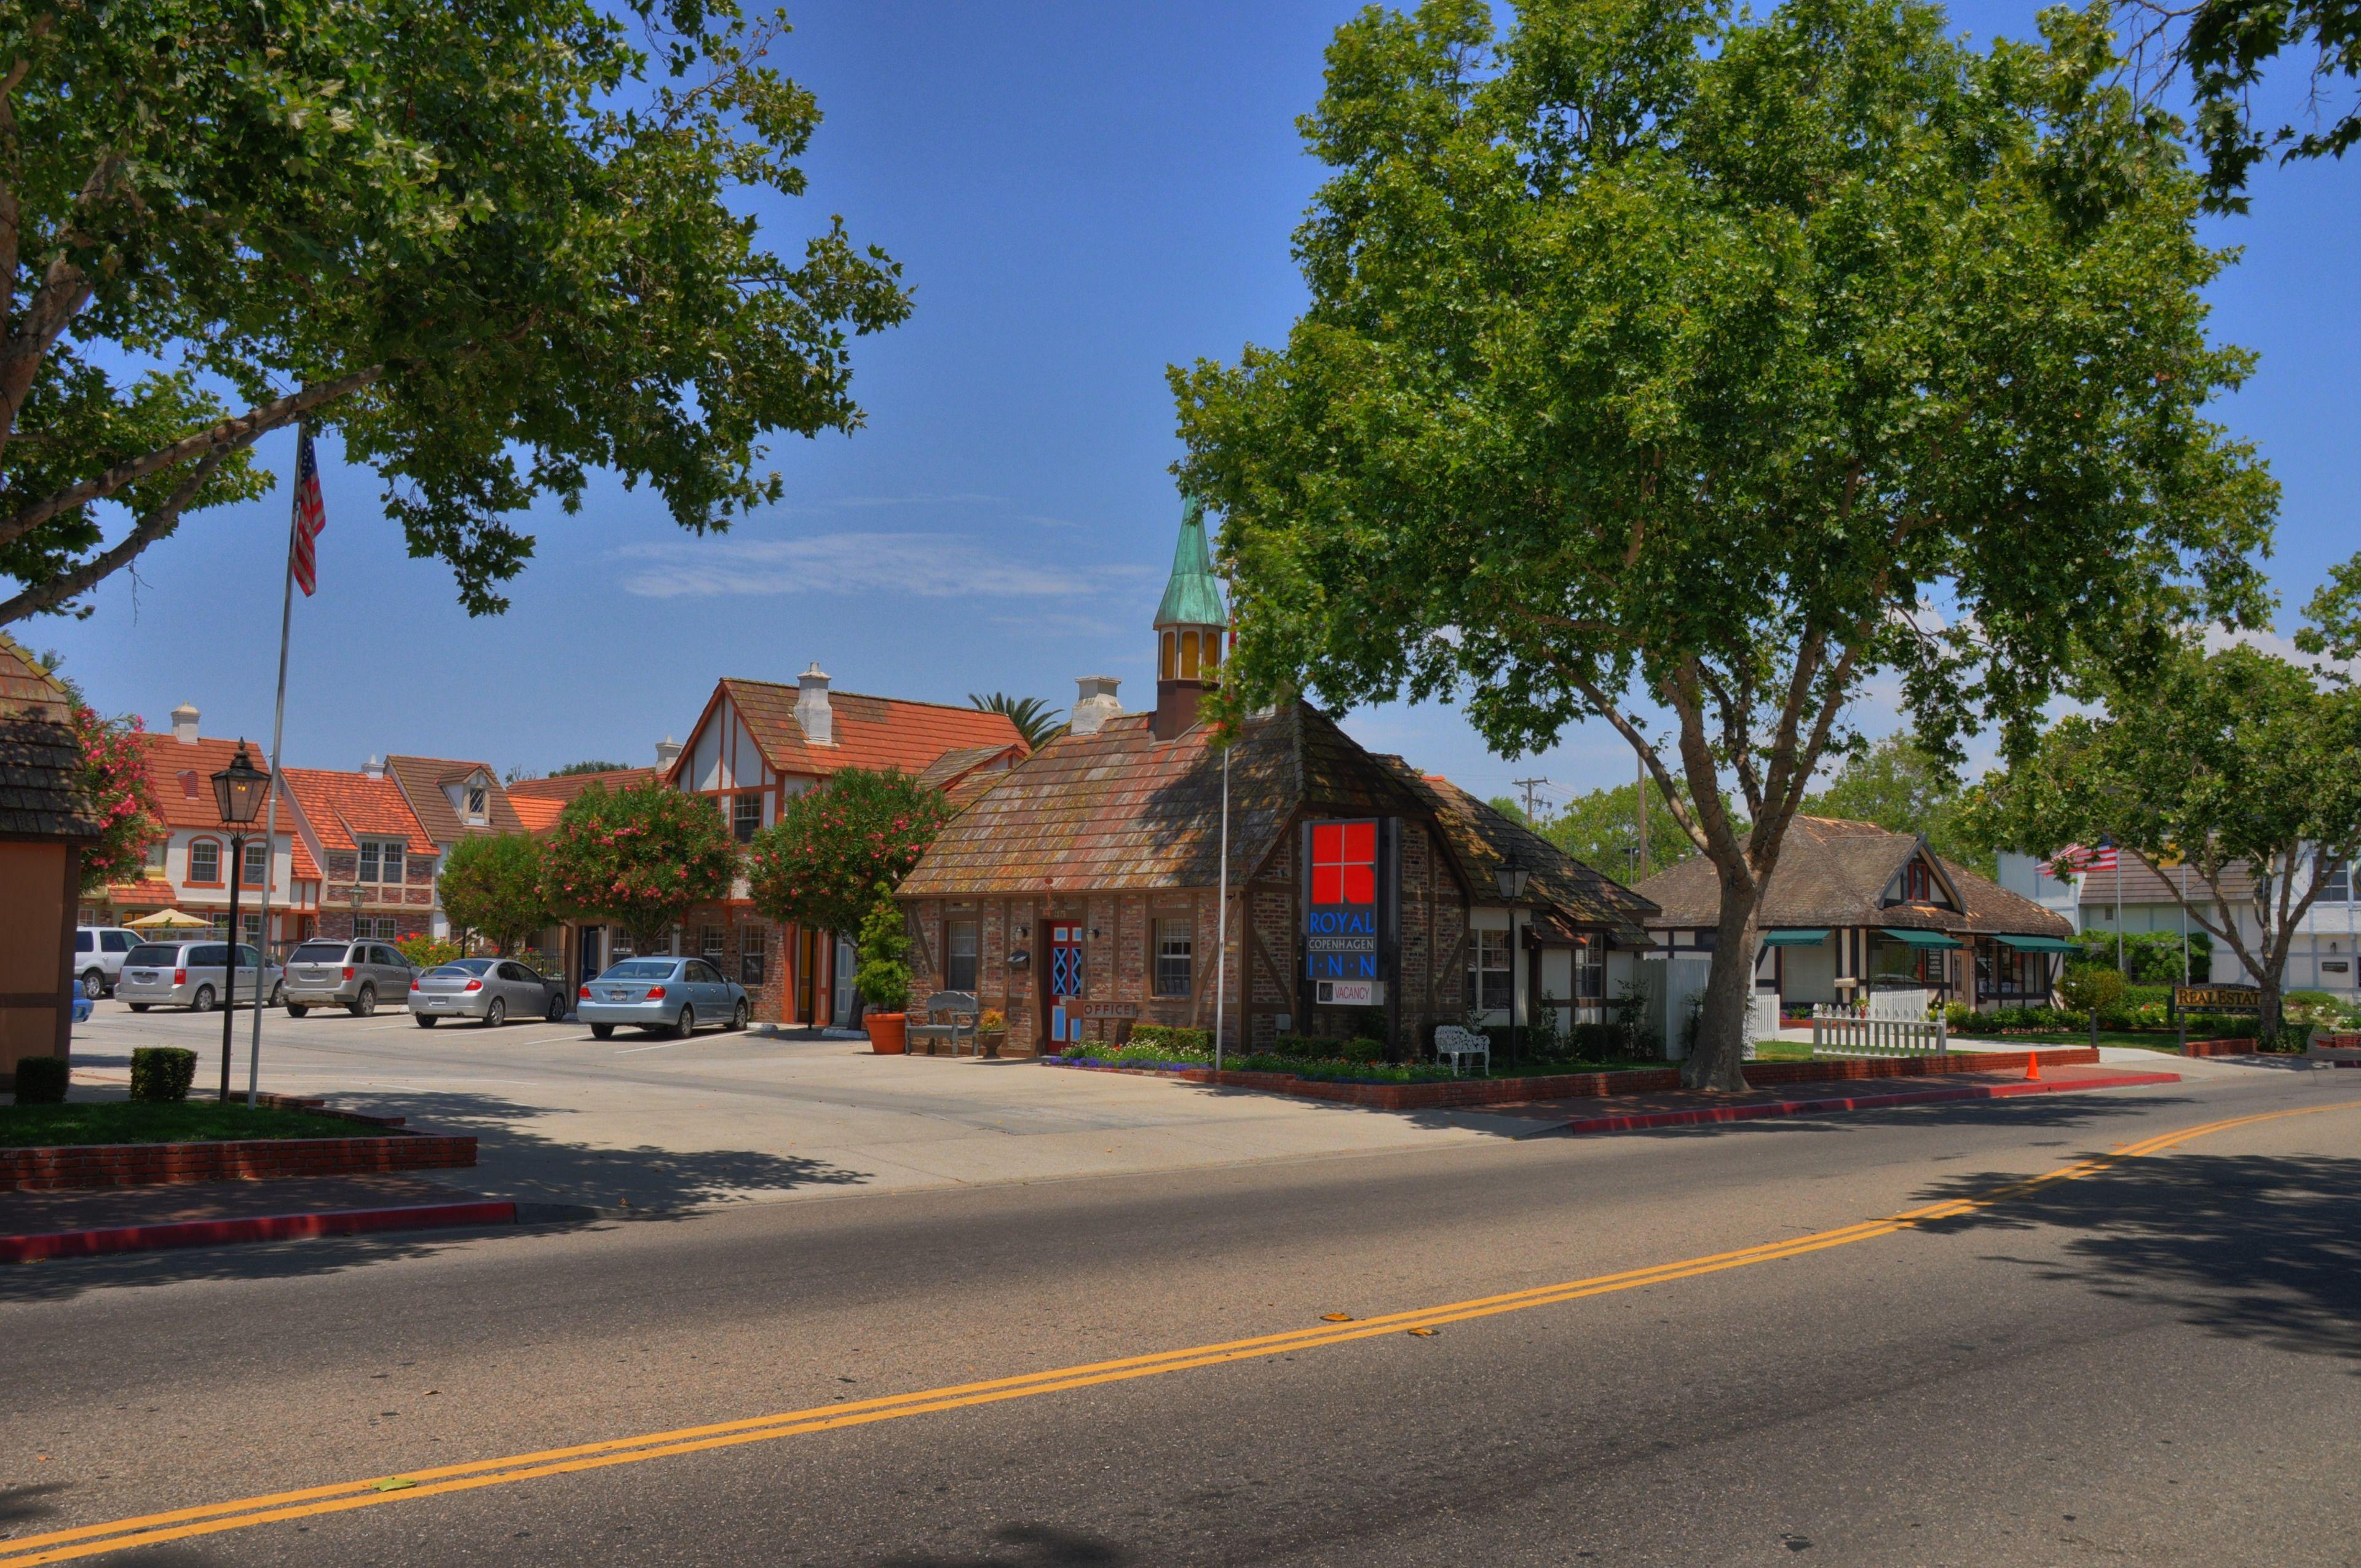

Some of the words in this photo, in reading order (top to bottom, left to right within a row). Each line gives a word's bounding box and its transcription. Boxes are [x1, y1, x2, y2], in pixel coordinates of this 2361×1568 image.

[1310, 912, 1375, 933] ROYAL
[1309, 939, 1374, 950] COPENHAGEN
[1335, 986, 1370, 999] VACANCY
[2178, 989, 2217, 1004] REAL
[2218, 990, 2260, 1005] ESTAT
[1084, 1004, 1130, 1015] OFFICE
